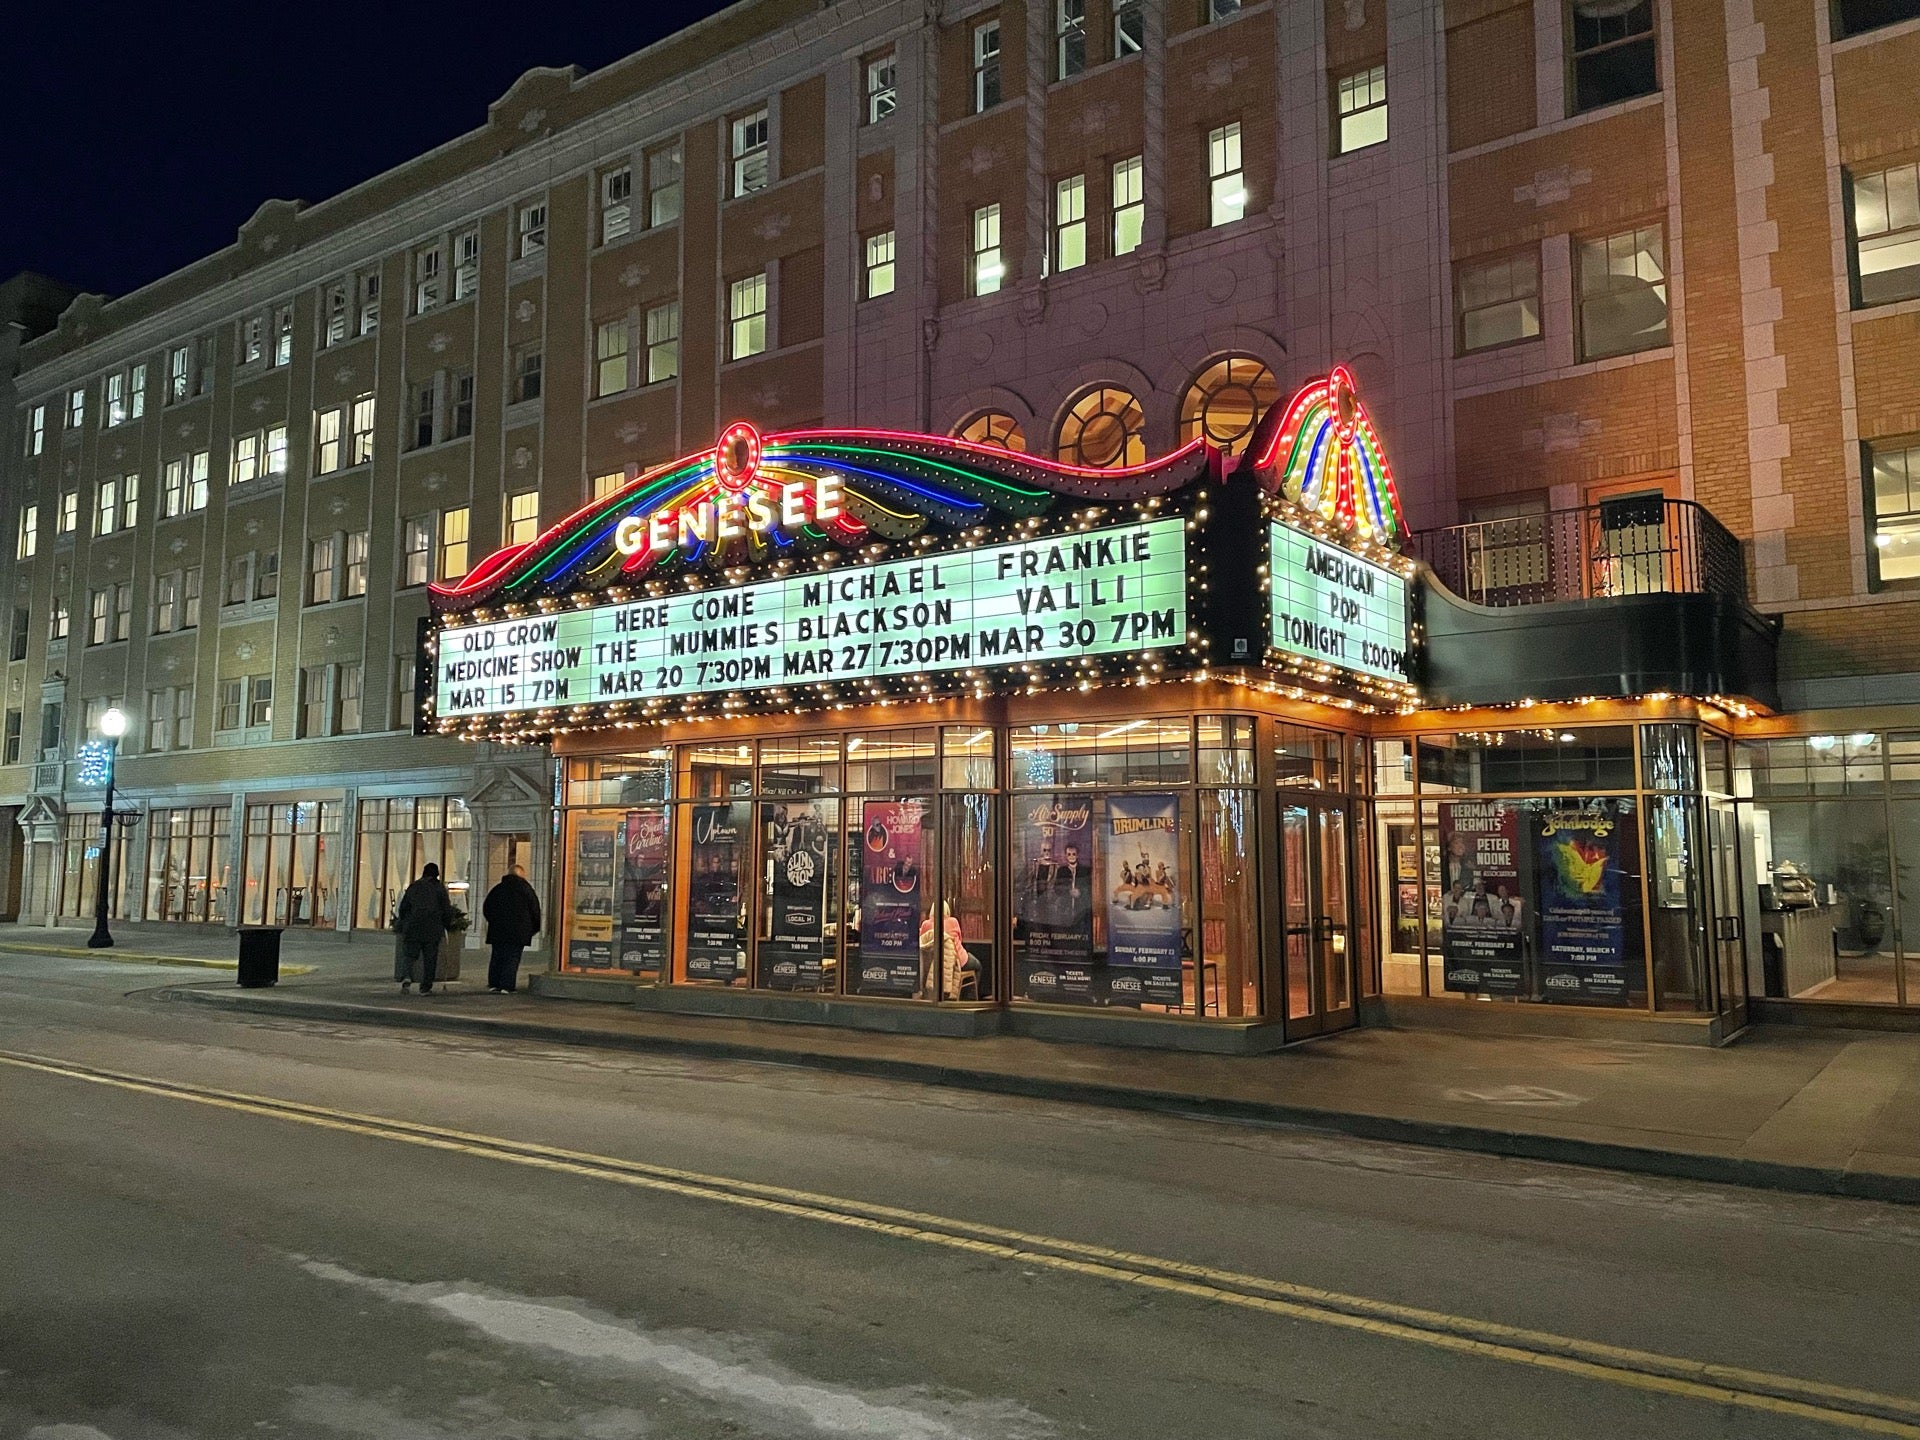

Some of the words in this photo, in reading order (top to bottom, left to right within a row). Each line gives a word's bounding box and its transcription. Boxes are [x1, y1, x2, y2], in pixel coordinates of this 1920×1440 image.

[615, 475, 842, 555] GENESEE
[998, 531, 1150, 580] FRANKIE
[1305, 545, 1375, 597] AMERICAN
[803, 564, 946, 608] MICHAEL
[1016, 575, 1124, 616] VALLI
[615, 604, 669, 632] HERE
[692, 591, 755, 621] COME
[799, 598, 951, 642] BLACKSON
[464, 631, 494, 652] OLD
[507, 620, 558, 646] CROW
[596, 639, 637, 665] THE
[670, 621, 779, 656] MUMMIES
[980, 624, 1044, 657] MAR
[1059, 619, 1096, 648] 30
[1111, 608, 1175, 643] 7PM
[1281, 612, 1347, 659] TONIGHT
[445, 654, 519, 683] MEDICINE
[530, 646, 582, 673] SHOW
[783, 648, 834, 676] MAR
[842, 643, 872, 671] 27
[880, 633, 970, 668] 7:30PM
[600, 669, 643, 695] MAR
[656, 664, 683, 689] 20
[696, 655, 771, 686] 7:30PM
[450, 687, 485, 710] MAR
[501, 684, 516, 704] 15
[532, 678, 569, 702] 7PM
[886, 815, 920, 825] HOWARD
[1028, 804, 1051, 822] Air
[1050, 803, 1089, 828] Supply
[1450, 803, 1504, 818] HERMAN'S
[1455, 818, 1501, 831] HERMITS
[696, 810, 738, 844] Uptown
[890, 824, 915, 834] JONES
[788, 850, 815, 871] BLIND
[888, 848, 895, 859] &
[1477, 838, 1509, 851] PETER
[689, 960, 711, 970] GENESEE
[773, 964, 797, 974] GENESEE
[862, 970, 888, 980] GENESEE
[1029, 974, 1057, 985] GENESEE
[1448, 972, 1480, 982] GENESEE
[1112, 981, 1141, 991] GENESEE
[1545, 977, 1580, 988] GENESEE
